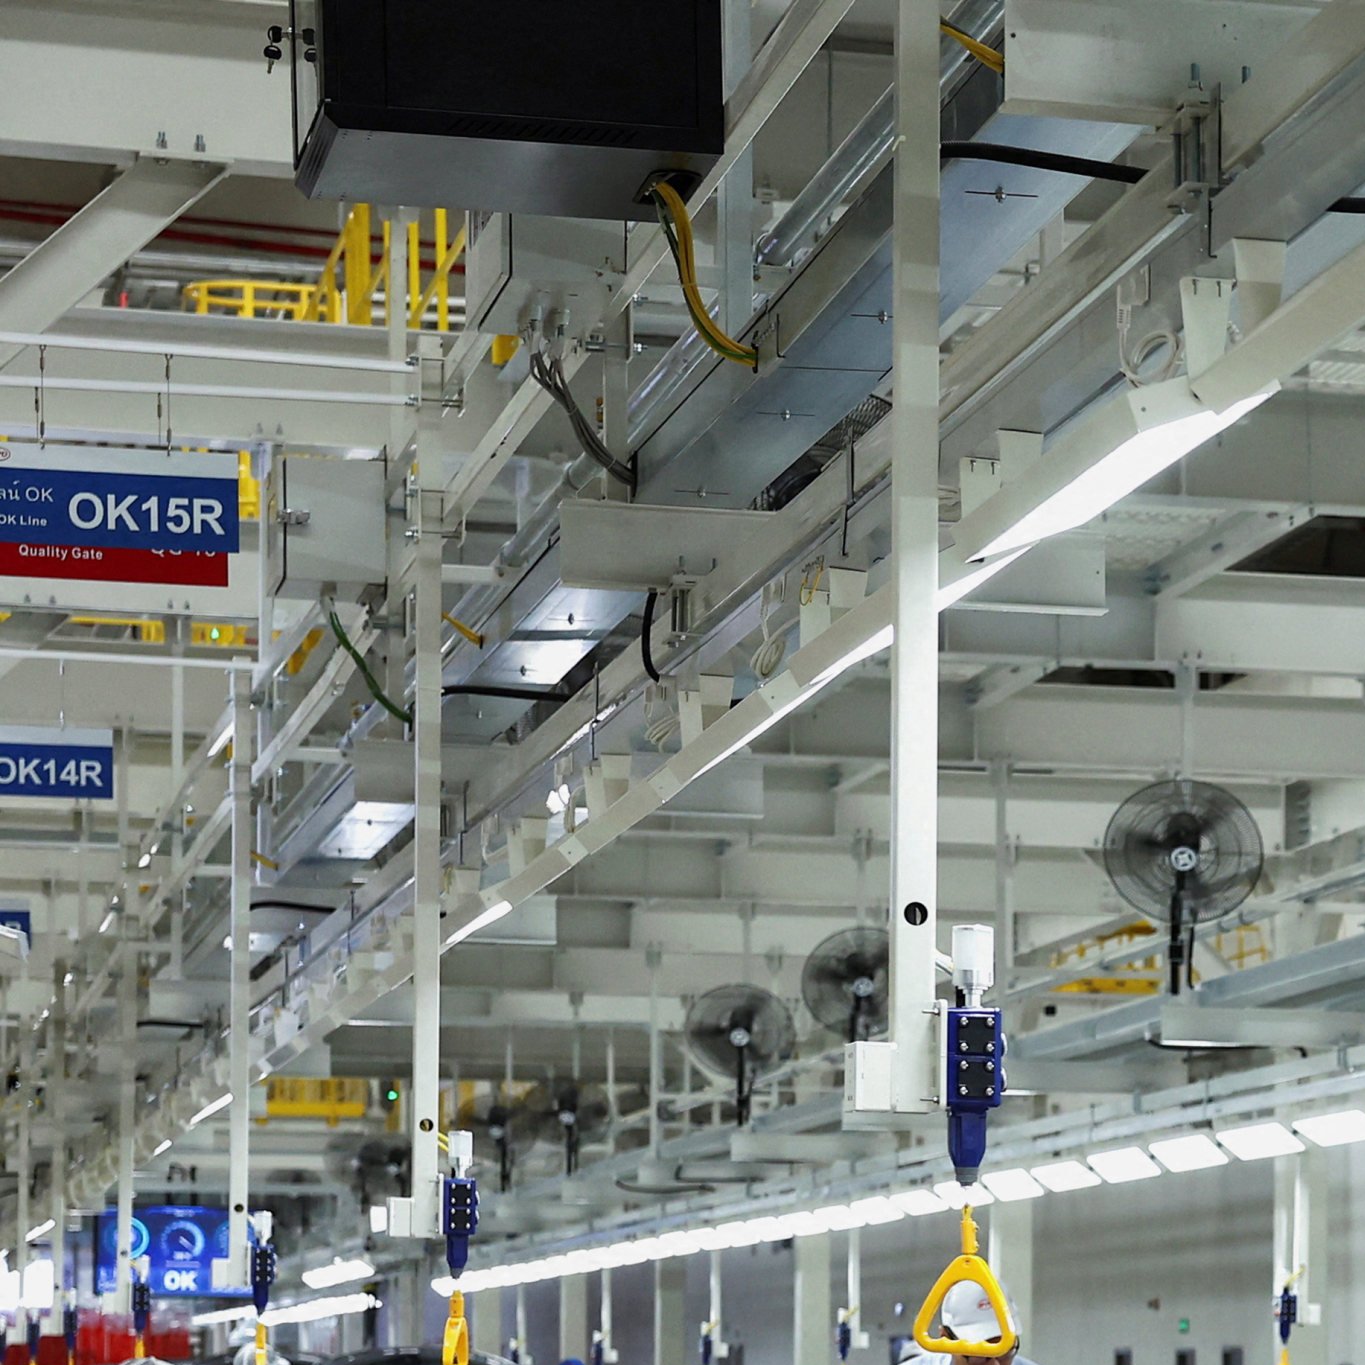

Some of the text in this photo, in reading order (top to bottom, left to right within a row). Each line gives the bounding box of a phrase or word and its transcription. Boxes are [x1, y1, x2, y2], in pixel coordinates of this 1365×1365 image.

[25, 486, 54, 502] OK
[20, 515, 48, 527] Line
[68, 492, 226, 536] OK15R
[18, 544, 103, 561] Quality Gate
[0, 757, 103, 787] OK14R
[163, 1270, 198, 1291] OK
